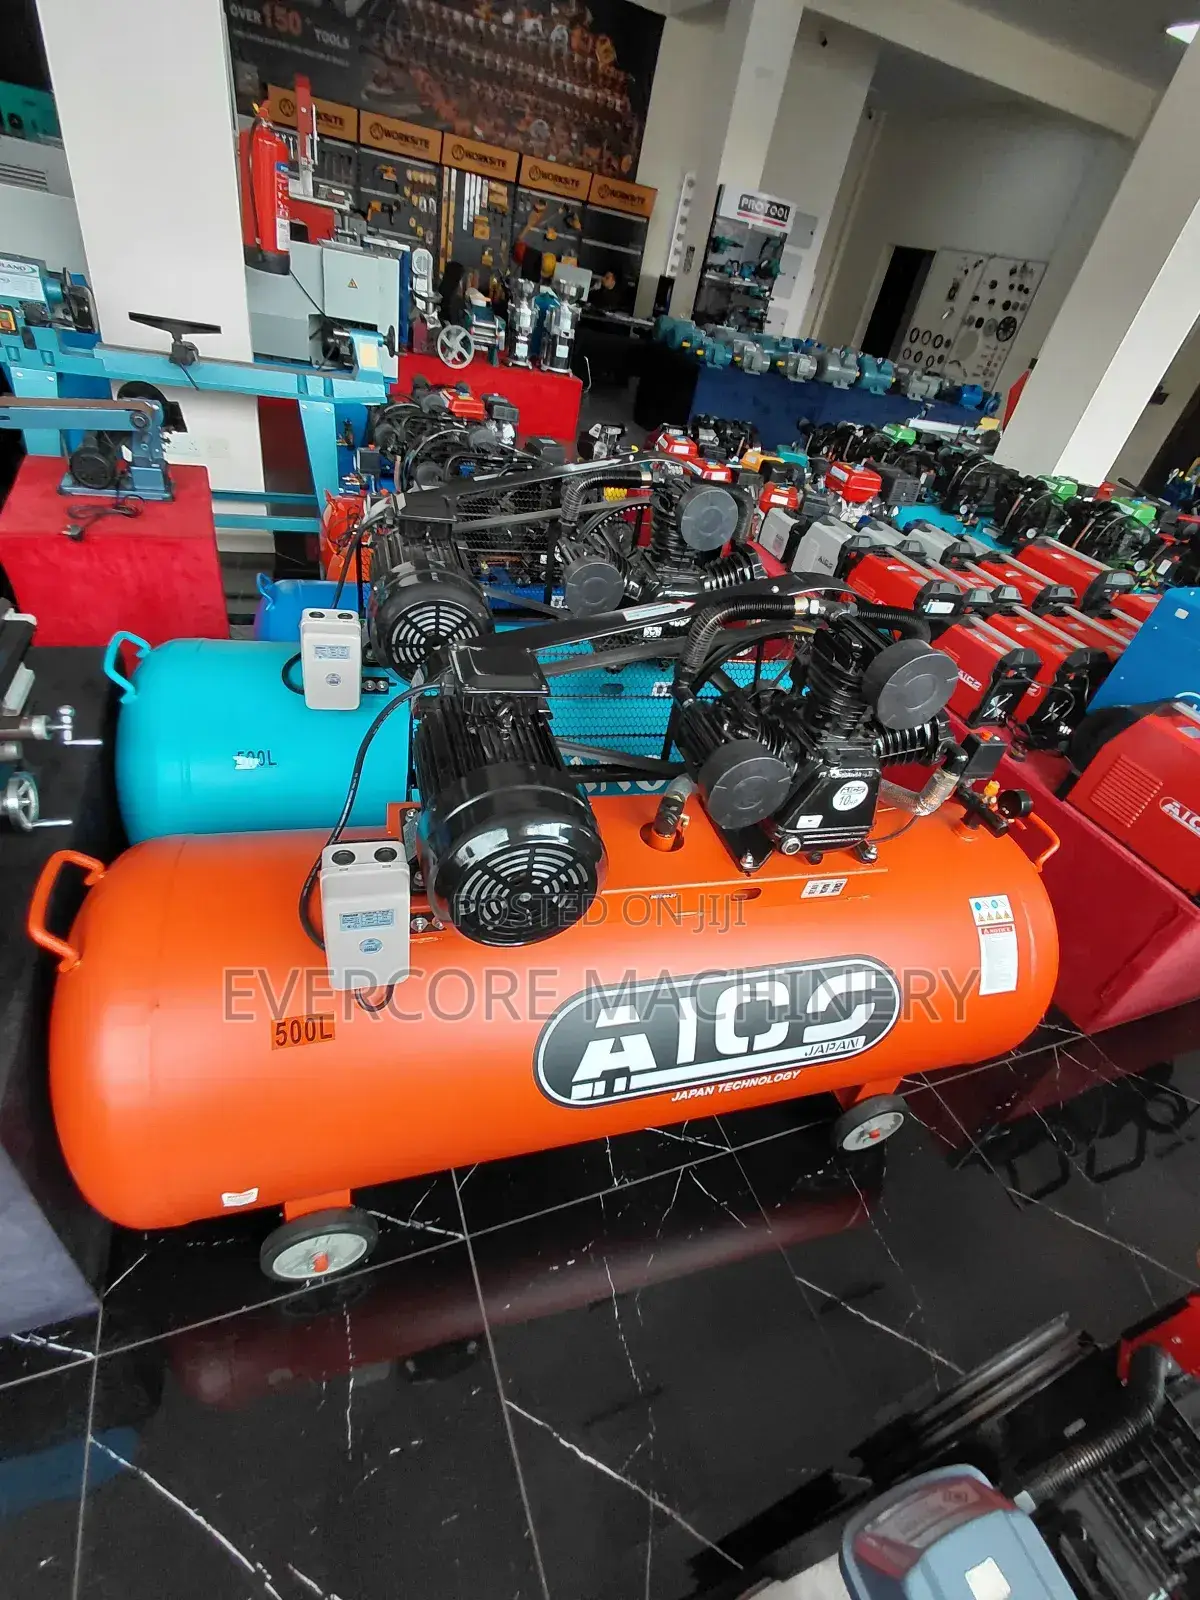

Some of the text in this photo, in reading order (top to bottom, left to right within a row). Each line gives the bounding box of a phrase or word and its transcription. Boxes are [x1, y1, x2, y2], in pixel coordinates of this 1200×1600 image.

[229, 2, 302, 36] OVER 150
[313, 28, 350, 49] TOOLS
[741, 197, 788, 220] PROTOOL
[989, 926, 1011, 934] NOTICE
[275, 1016, 333, 1047] 500L
[804, 1037, 861, 1057] JAPAN
[671, 1069, 802, 1102] JAPAN TECHNOLOGY
